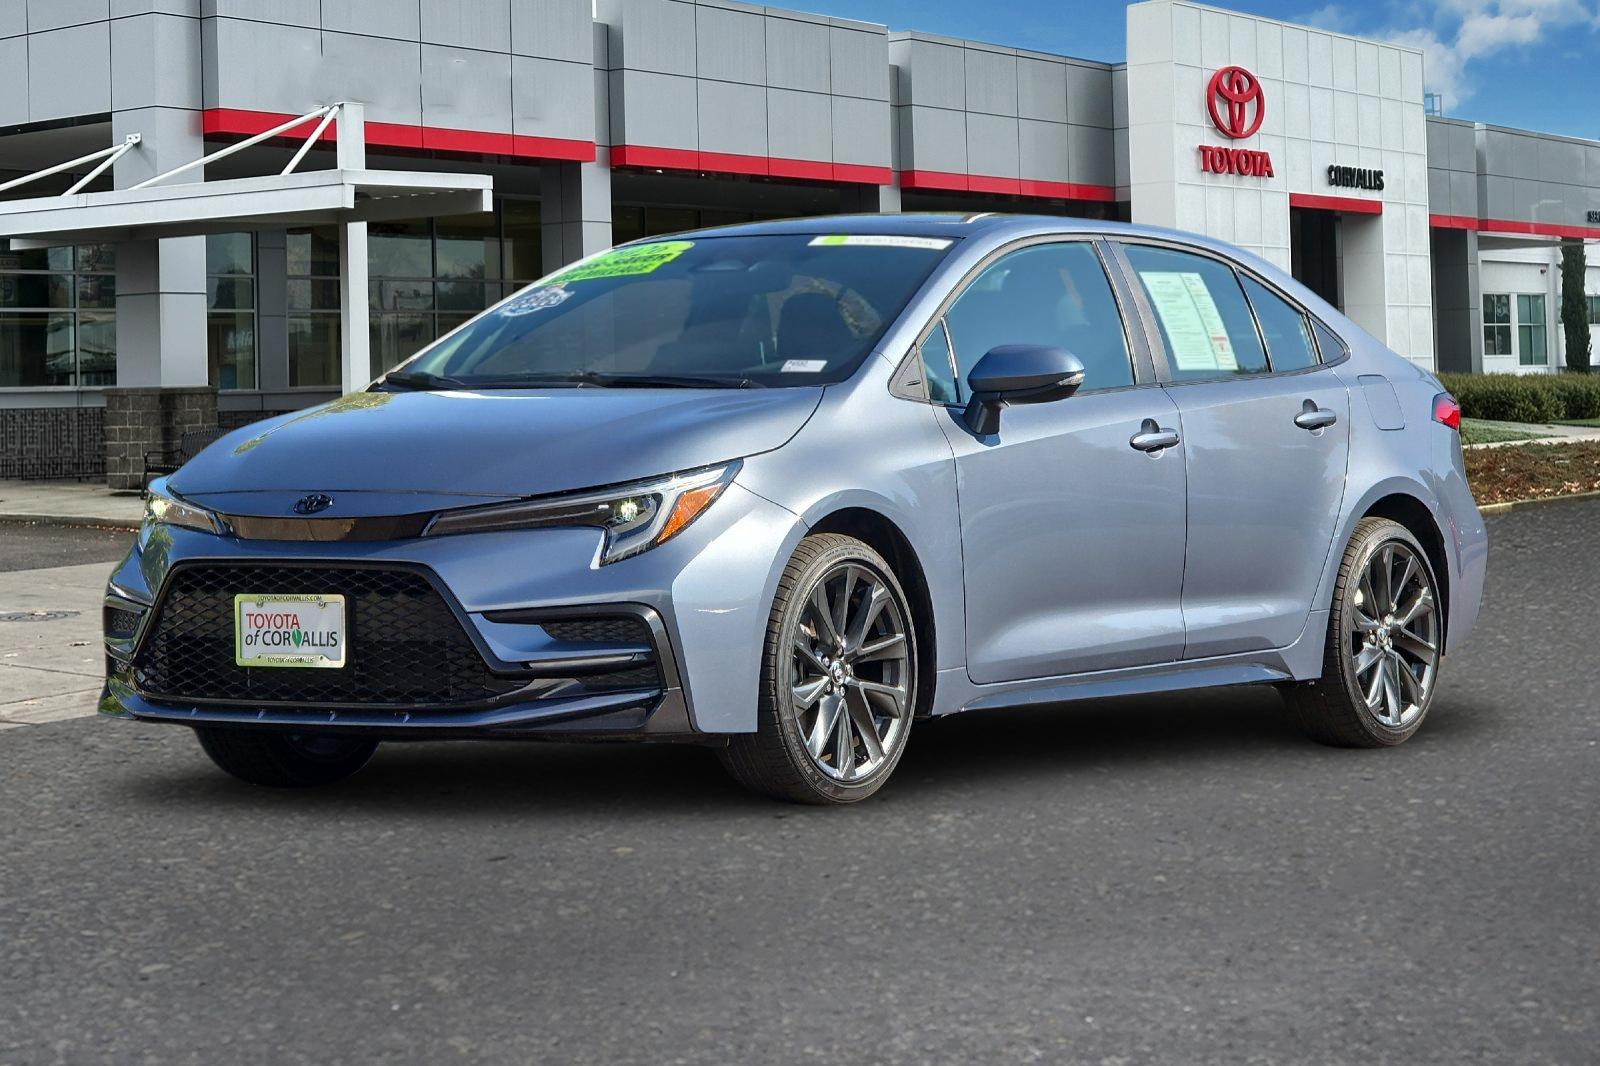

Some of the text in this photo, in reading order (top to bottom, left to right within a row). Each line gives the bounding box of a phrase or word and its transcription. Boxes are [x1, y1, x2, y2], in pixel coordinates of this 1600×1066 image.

[1199, 145, 1274, 177] TOYOTA
[1327, 165, 1384, 190] CORVALLIS
[246, 613, 300, 629] TOYOTA
[245, 630, 260, 645] of
